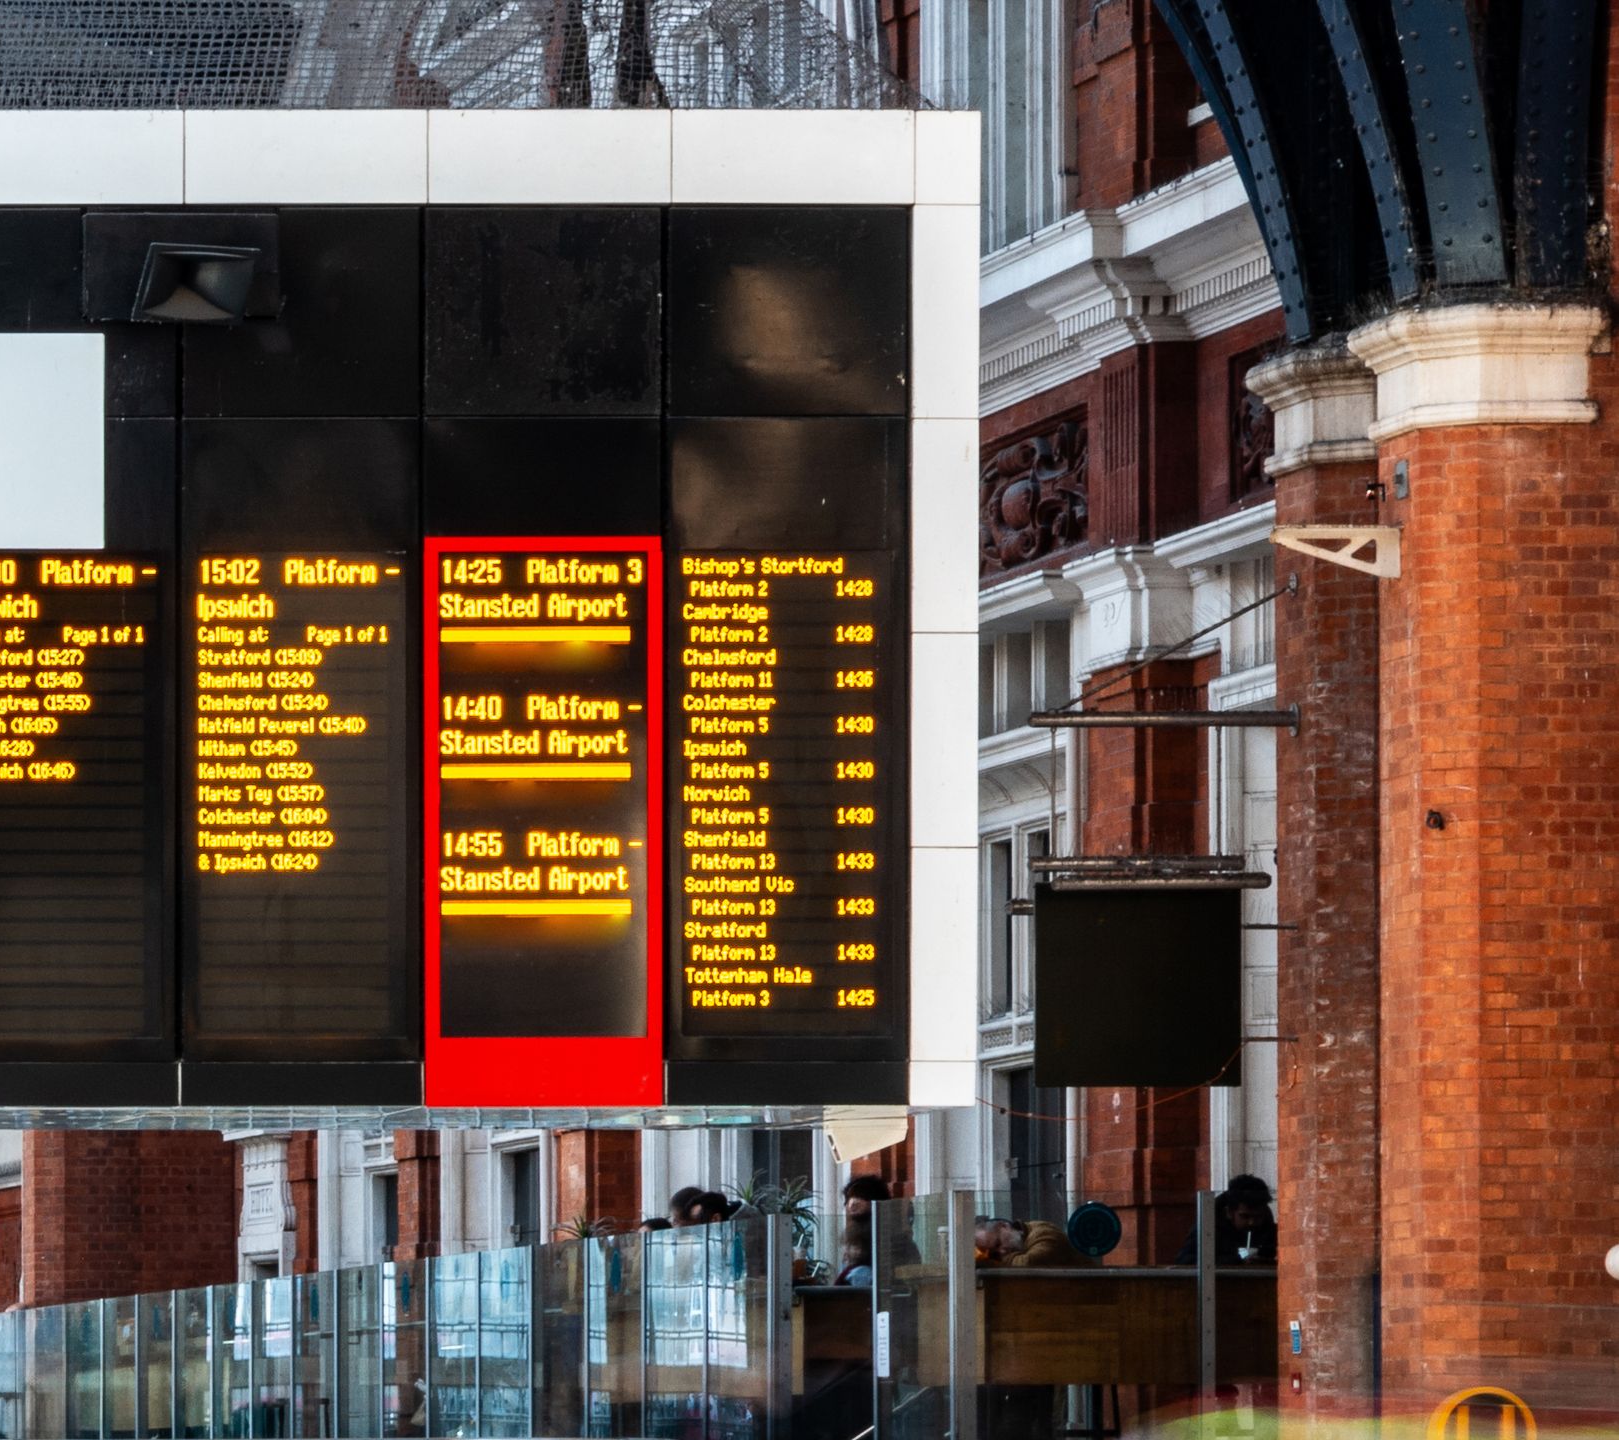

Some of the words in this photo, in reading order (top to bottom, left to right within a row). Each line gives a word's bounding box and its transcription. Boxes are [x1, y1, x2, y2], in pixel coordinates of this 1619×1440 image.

[442, 558, 502, 584] 14:25
[526, 558, 620, 584] Platform
[627, 558, 643, 584] 3
[682, 557, 756, 577] Bishop's
[760, 557, 844, 575] Stortford
[690, 580, 755, 598] Platform
[757, 579, 769, 597] 2
[439, 593, 540, 619] Stansted
[547, 592, 628, 622] Airport
